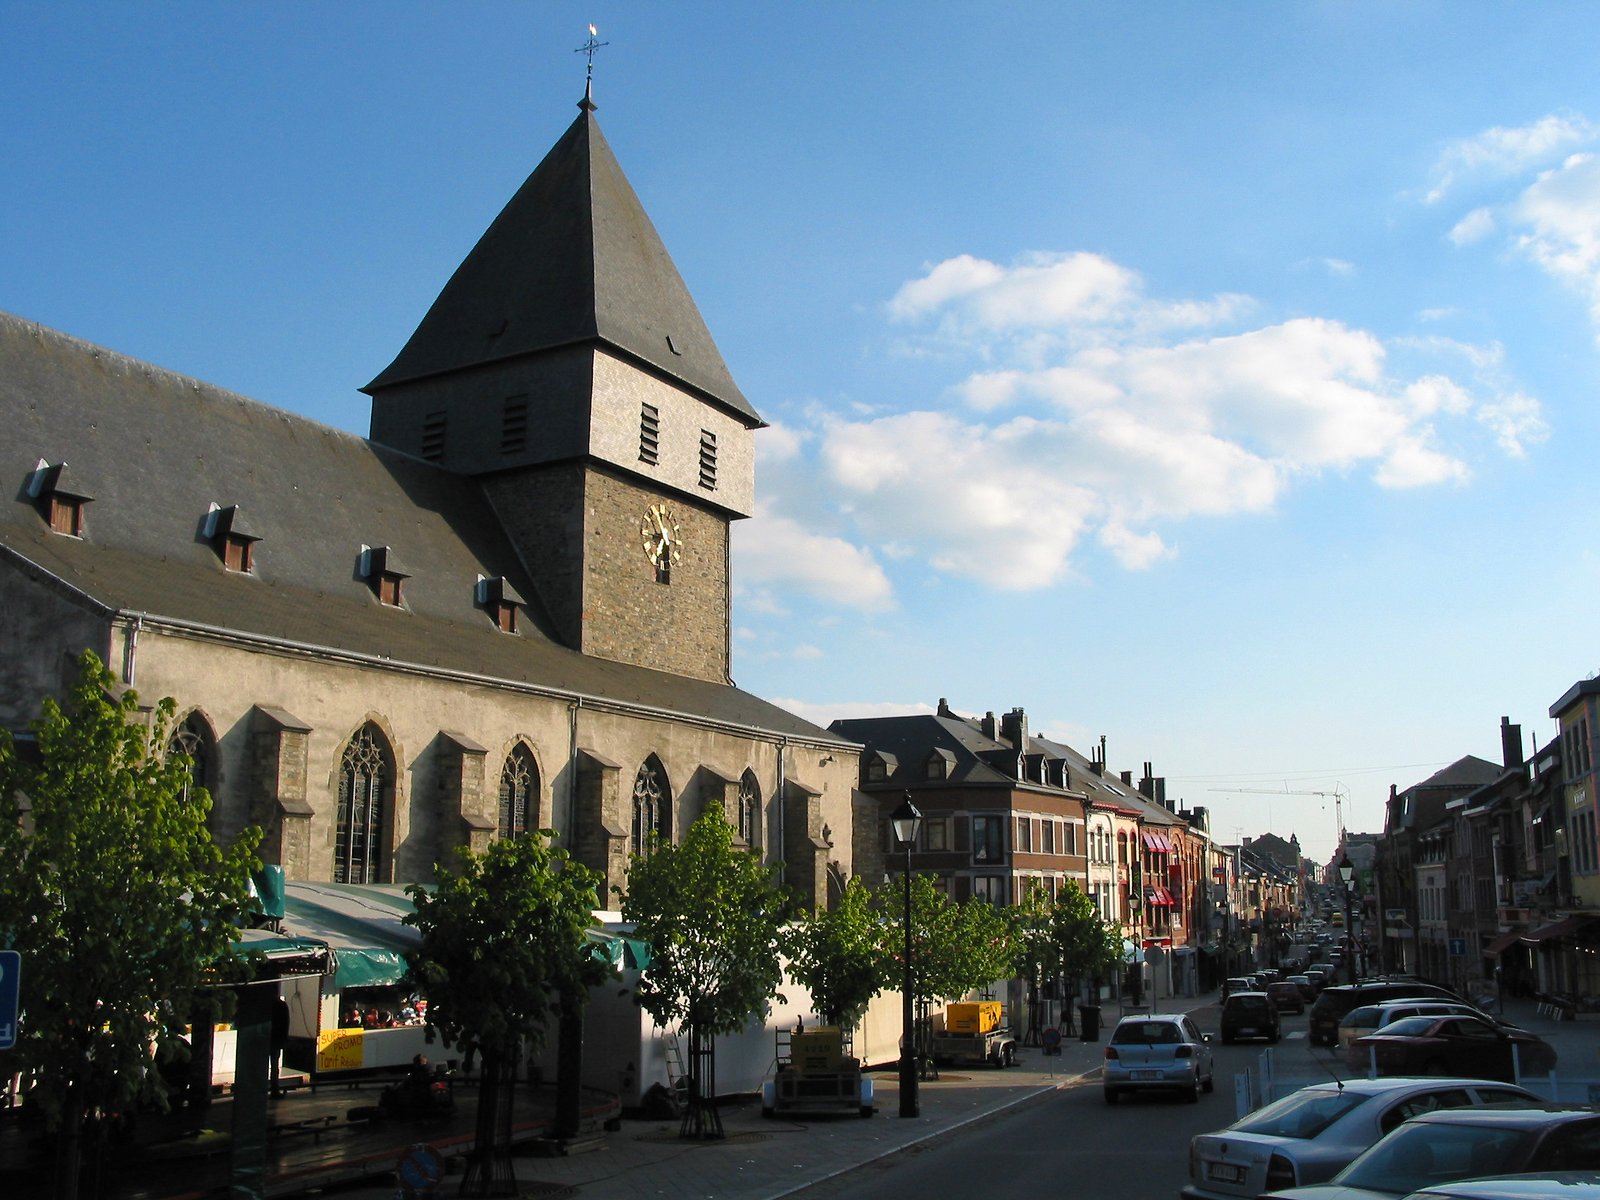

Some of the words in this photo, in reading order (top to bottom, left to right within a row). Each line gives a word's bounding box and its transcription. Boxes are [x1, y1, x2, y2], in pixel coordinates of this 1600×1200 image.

[321, 1029, 346, 1044] SUPER
[333, 1035, 362, 1052] PROMO
[319, 1052, 339, 1069] Tarif
